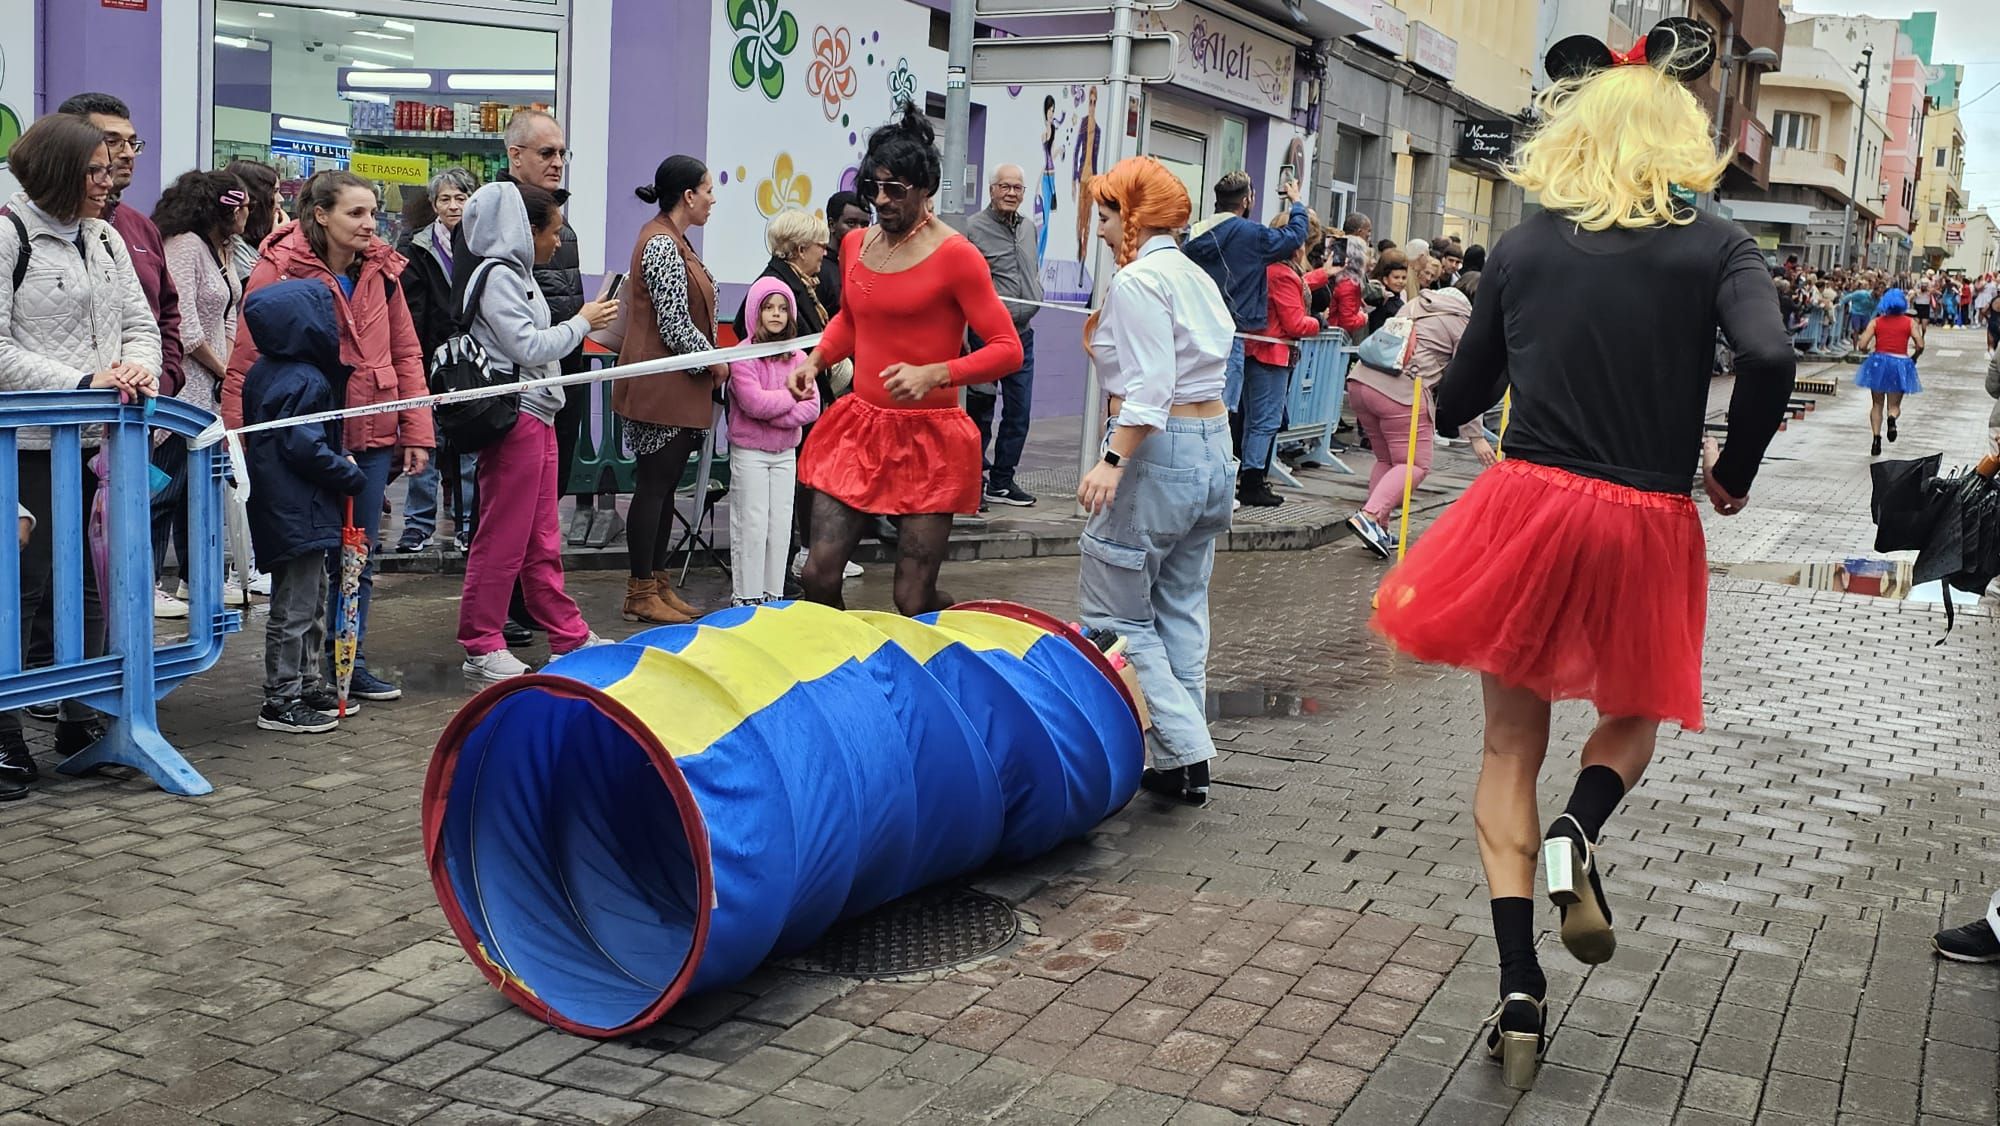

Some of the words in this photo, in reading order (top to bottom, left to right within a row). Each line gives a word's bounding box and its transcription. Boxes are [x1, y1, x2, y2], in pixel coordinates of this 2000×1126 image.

[1472, 138, 1500, 155] Shop
[356, 163, 369, 173] SE
[371, 164, 422, 177] TRASPASA
